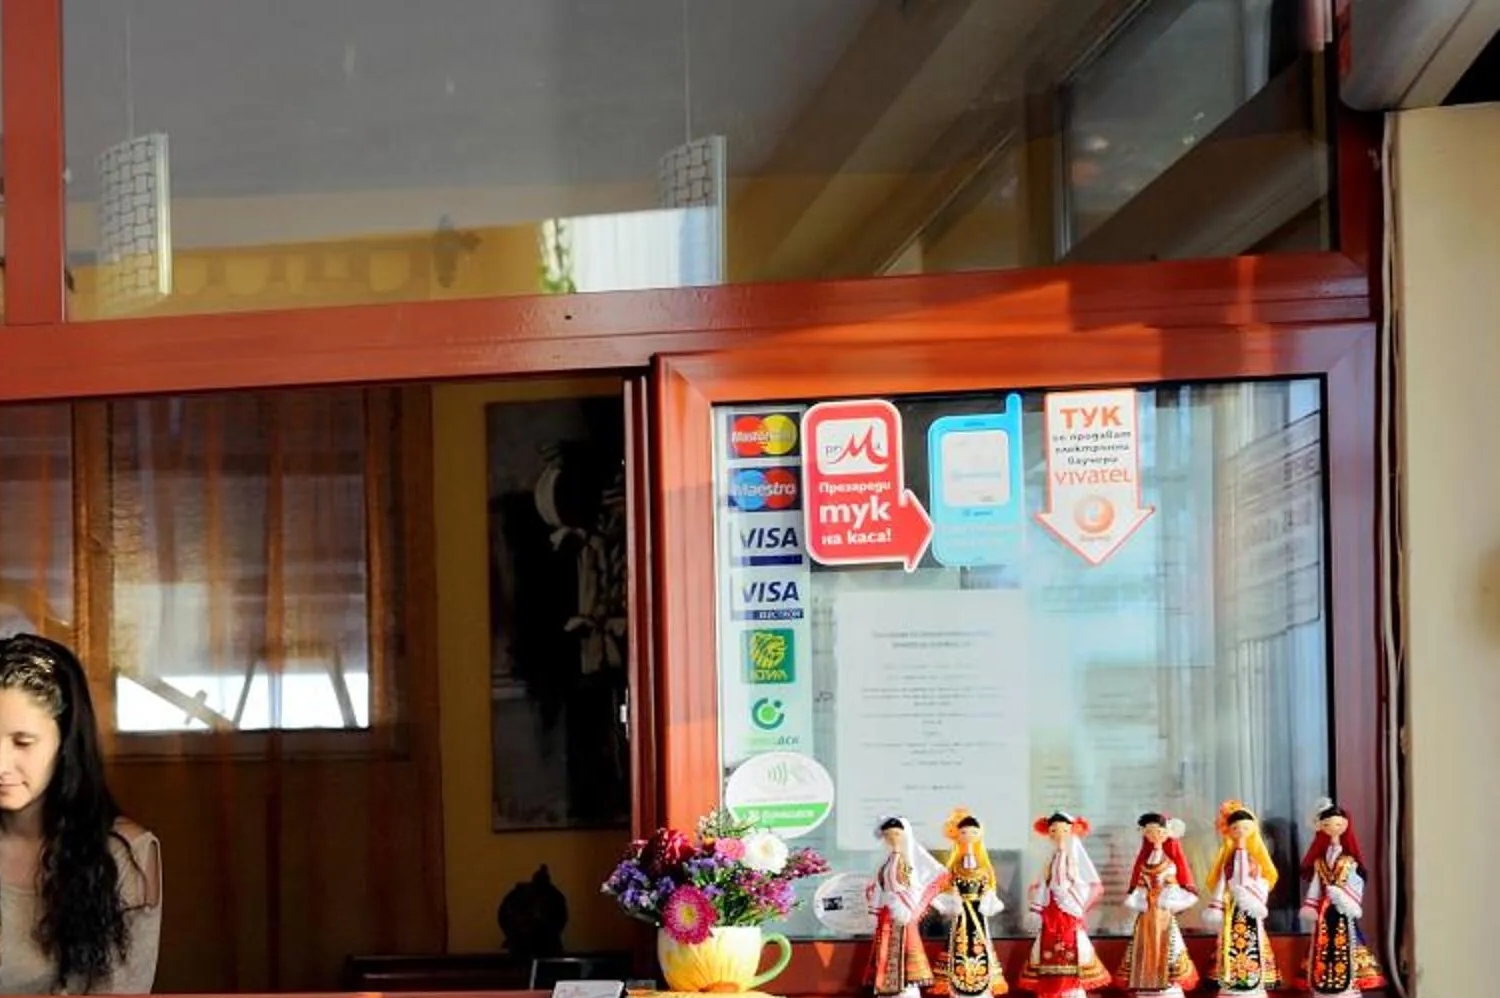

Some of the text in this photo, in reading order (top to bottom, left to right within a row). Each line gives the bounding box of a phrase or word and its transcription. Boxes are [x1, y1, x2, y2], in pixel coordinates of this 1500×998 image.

[1059, 405, 1122, 429] ТУК
[735, 482, 796, 497] Maestro
[740, 527, 799, 548] VISA
[742, 581, 799, 603] VISA
